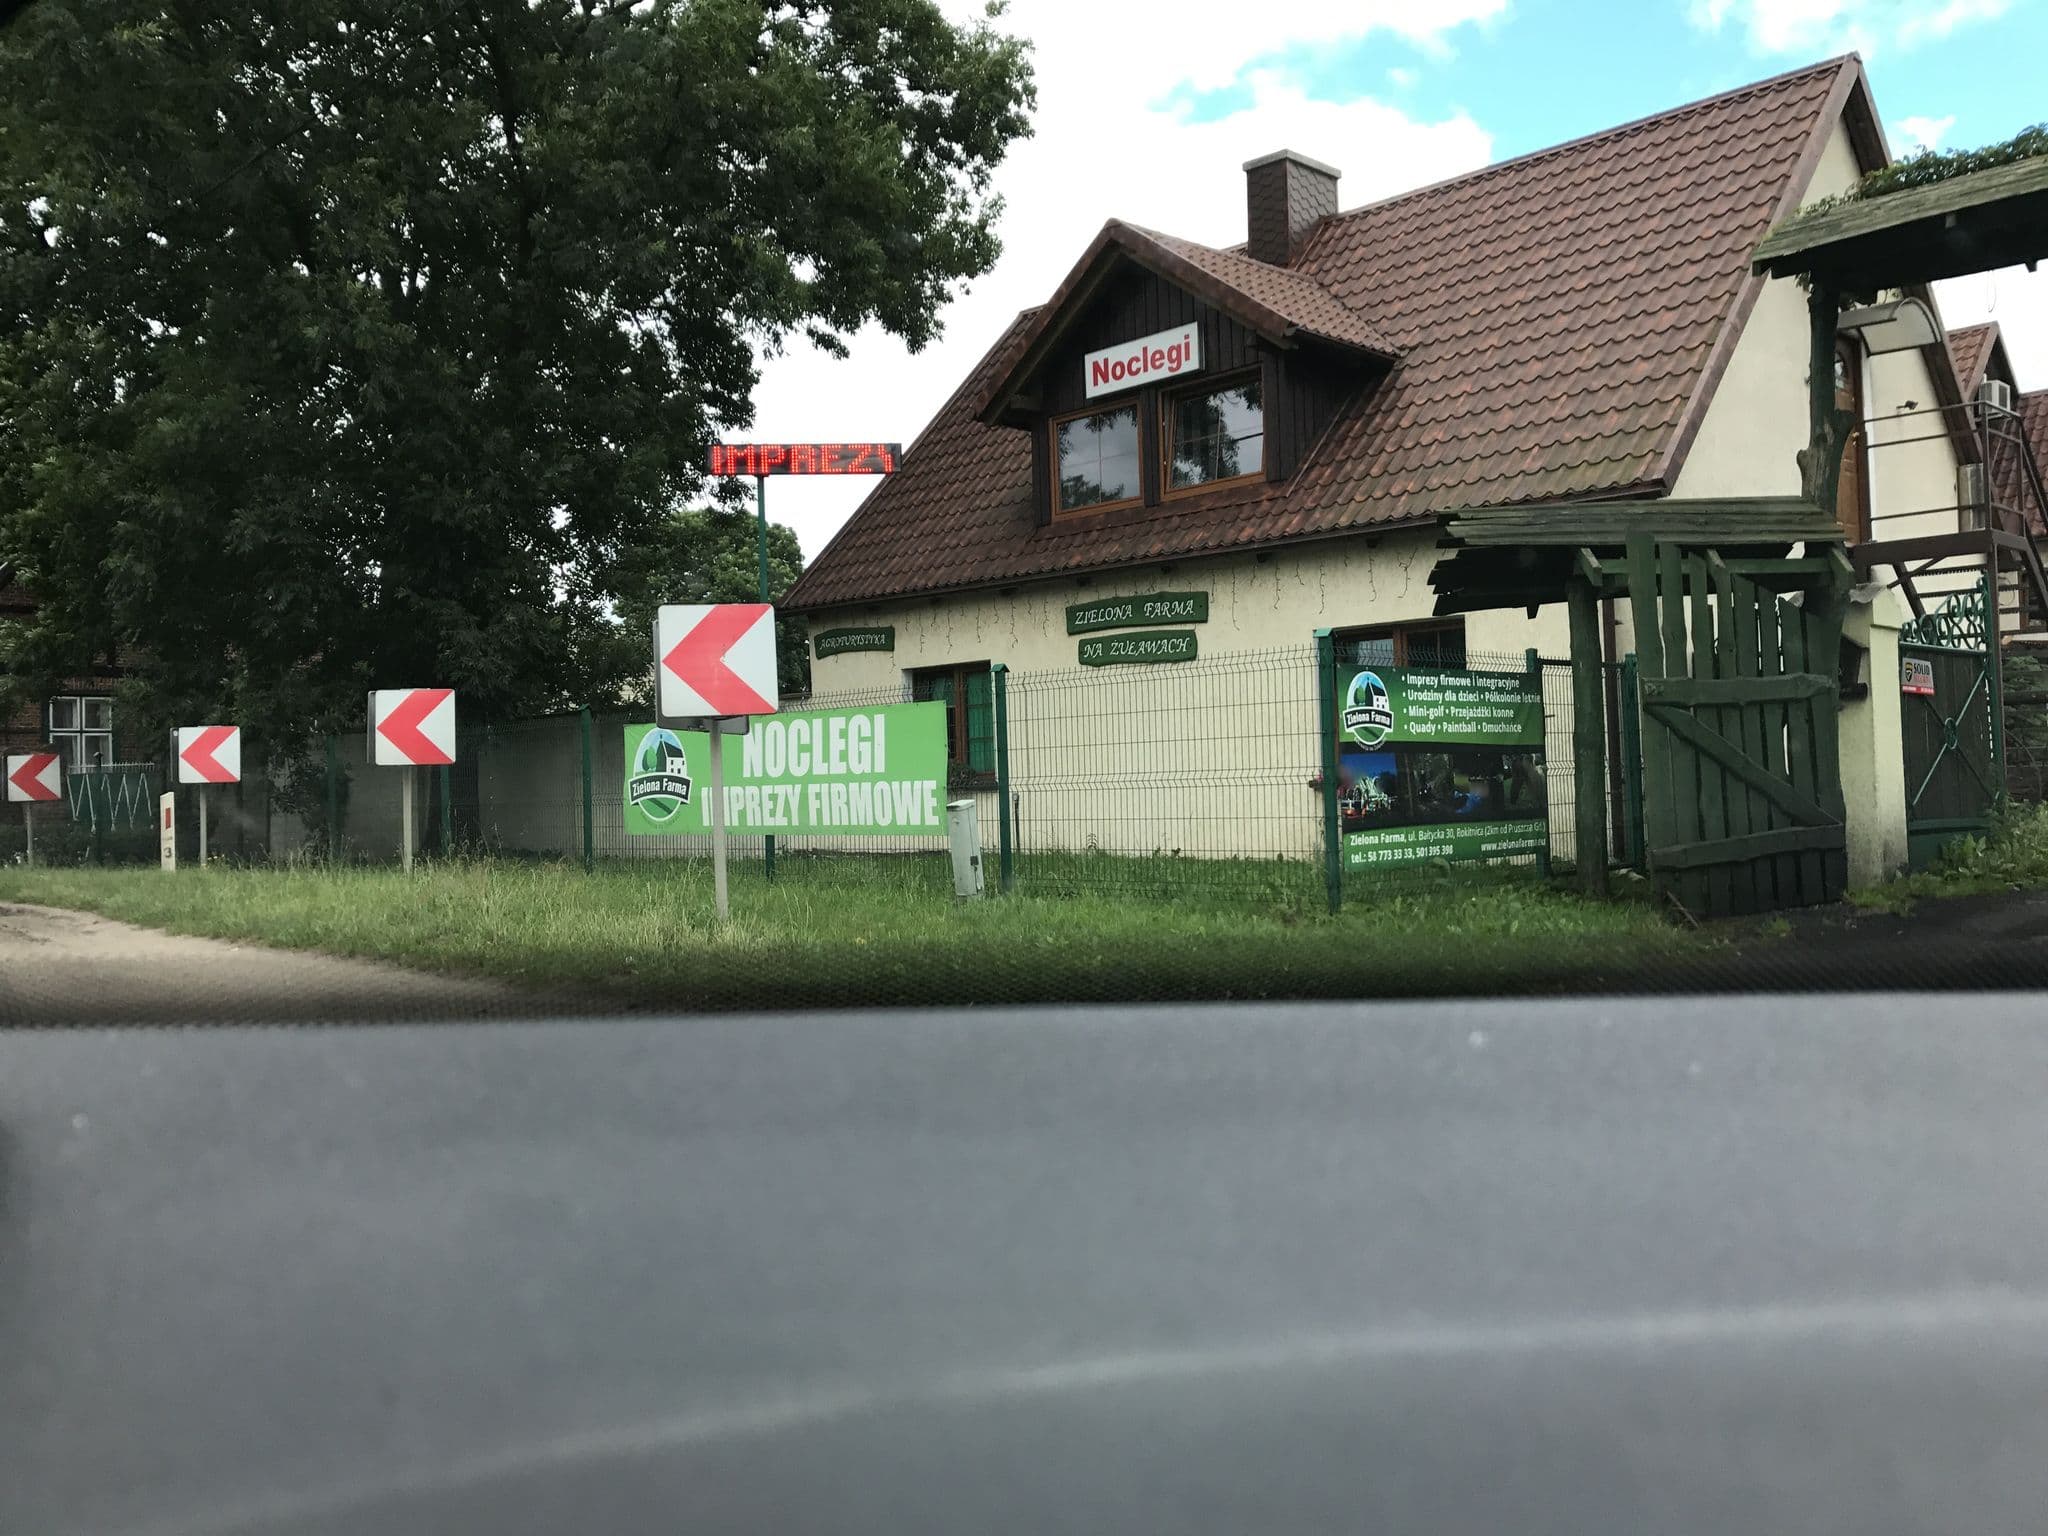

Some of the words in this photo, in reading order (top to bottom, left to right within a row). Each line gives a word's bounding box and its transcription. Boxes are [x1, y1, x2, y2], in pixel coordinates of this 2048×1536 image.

[1092, 334, 1191, 387] Noclegi
[1074, 604, 1133, 625] ZIELONA
[1143, 599, 1194, 618] FARMA
[1083, 643, 1103, 658] NA
[1406, 673, 1438, 688] Imprezy
[1440, 674, 1471, 686] firmowe
[1476, 676, 1520, 690] integracyjne
[1408, 690, 1443, 704] Urodziny
[1444, 690, 1459, 702] dla
[1459, 691, 1479, 702] dzieci
[1485, 691, 1521, 703] Półkolonie
[1347, 711, 1370, 725] Zielona
[1370, 710, 1390, 724] Farma
[1408, 705, 1444, 720] Mini-golf
[1492, 706, 1514, 718] konne
[1410, 722, 1436, 735] Quady
[1442, 722, 1477, 733] Paintball
[743, 714, 885, 778] NOCLEGI
[632, 780, 660, 797] Zielona
[662, 778, 687, 795] Farma
[808, 779, 939, 826] FIRMOWE
[1350, 833, 1378, 846] Zielona
[1380, 832, 1406, 844] Farma,
[1351, 852, 1366, 863] tel.:
[1368, 851, 1377, 862] 58
[1378, 850, 1392, 860] 773
[1394, 849, 1402, 860] 33
[1416, 847, 1428, 858] 501
[1429, 846, 1440, 856] 395
